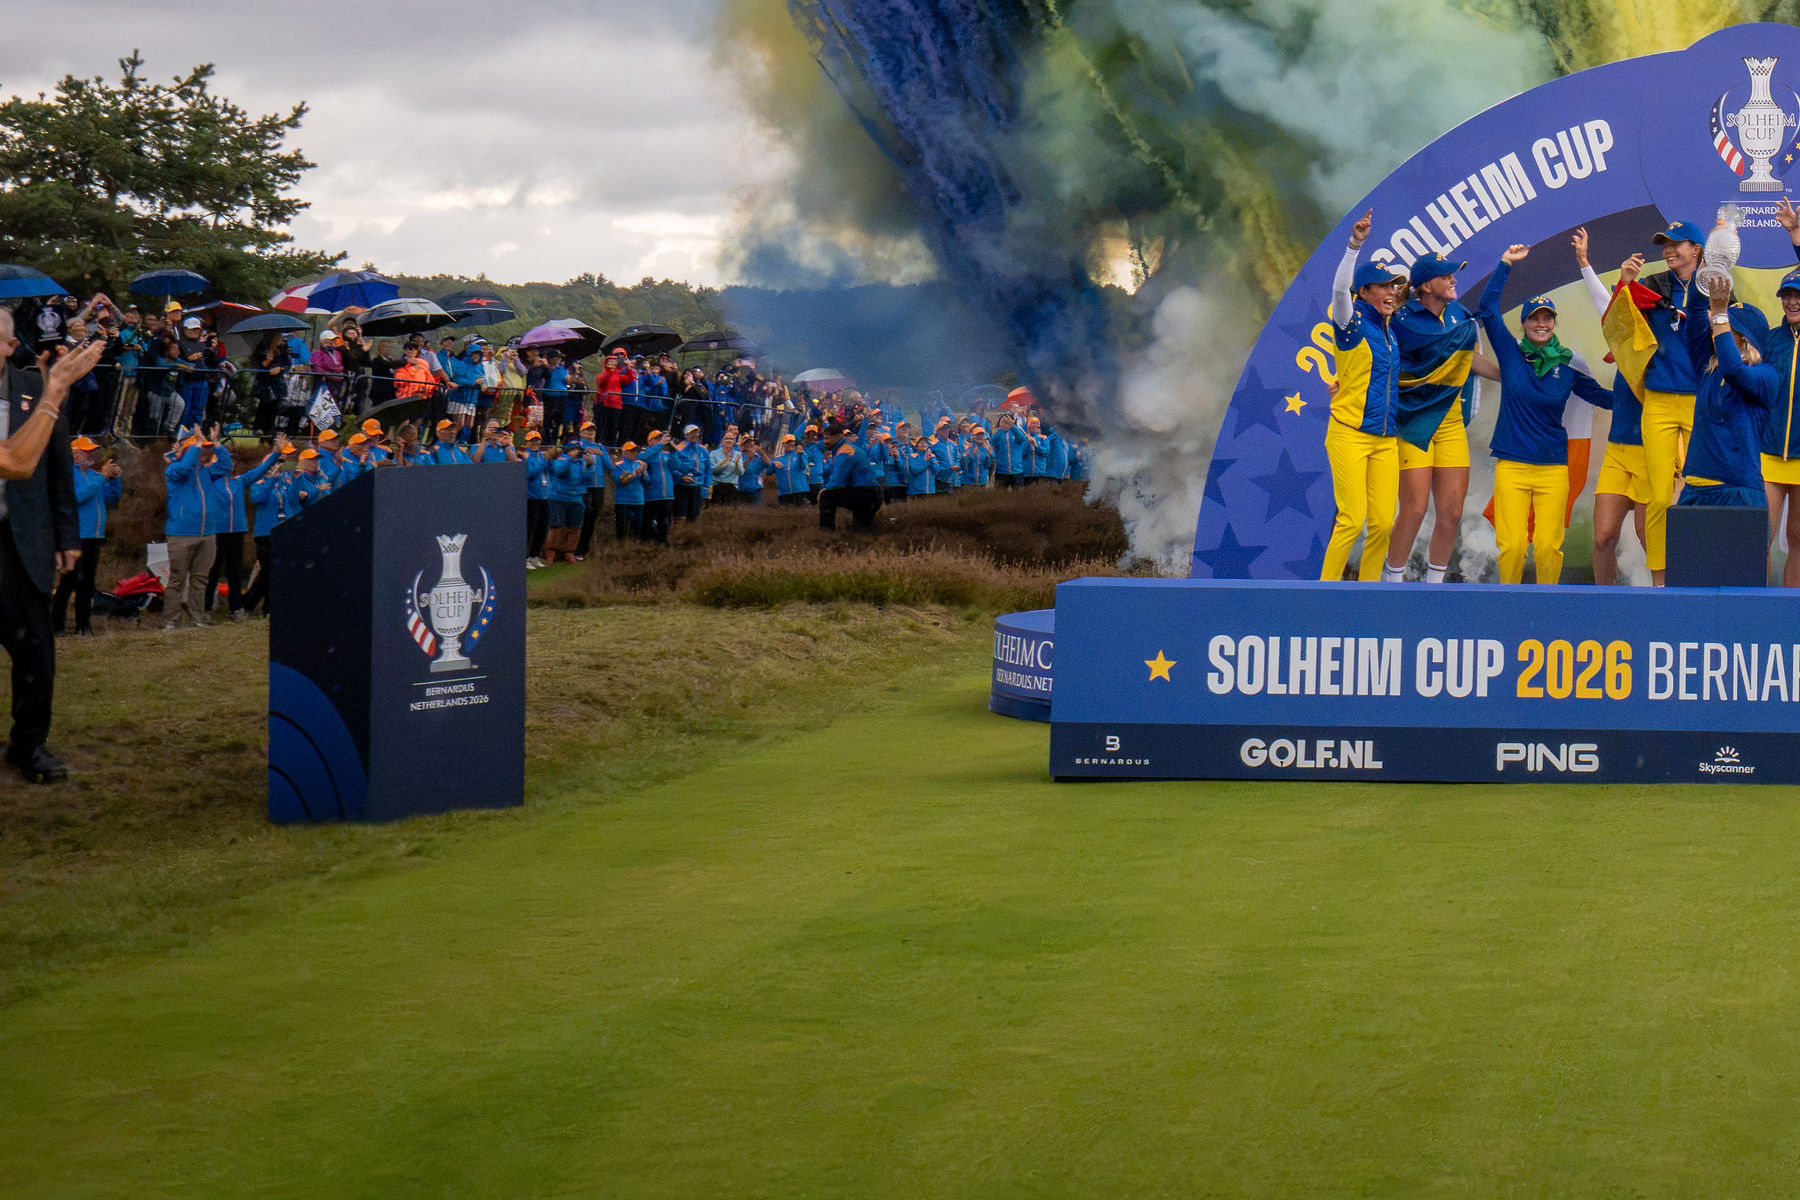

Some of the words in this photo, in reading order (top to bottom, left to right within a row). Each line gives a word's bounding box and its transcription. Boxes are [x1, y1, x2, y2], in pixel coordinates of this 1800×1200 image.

[1726, 112, 1796, 128] SOLHEIM
[1745, 127, 1776, 140] CUP
[1370, 152, 1537, 281] SOLHEIM
[1532, 119, 1614, 189] CUP
[419, 588, 483, 608] SOLHEIM
[437, 604, 465, 618] CUP
[1207, 635, 1402, 696] SOLHEIM
[1415, 638, 1504, 698] CUP
[1516, 639, 1632, 700] 2026
[425, 683, 475, 697] BERNARDUS
[410, 697, 469, 712] NETHERLANDS
[468, 695, 489, 705] 2026
[1240, 738, 1383, 769] GOLF.NL
[1496, 742, 1600, 772] PING
[1699, 762, 1755, 774] Skyscanner
